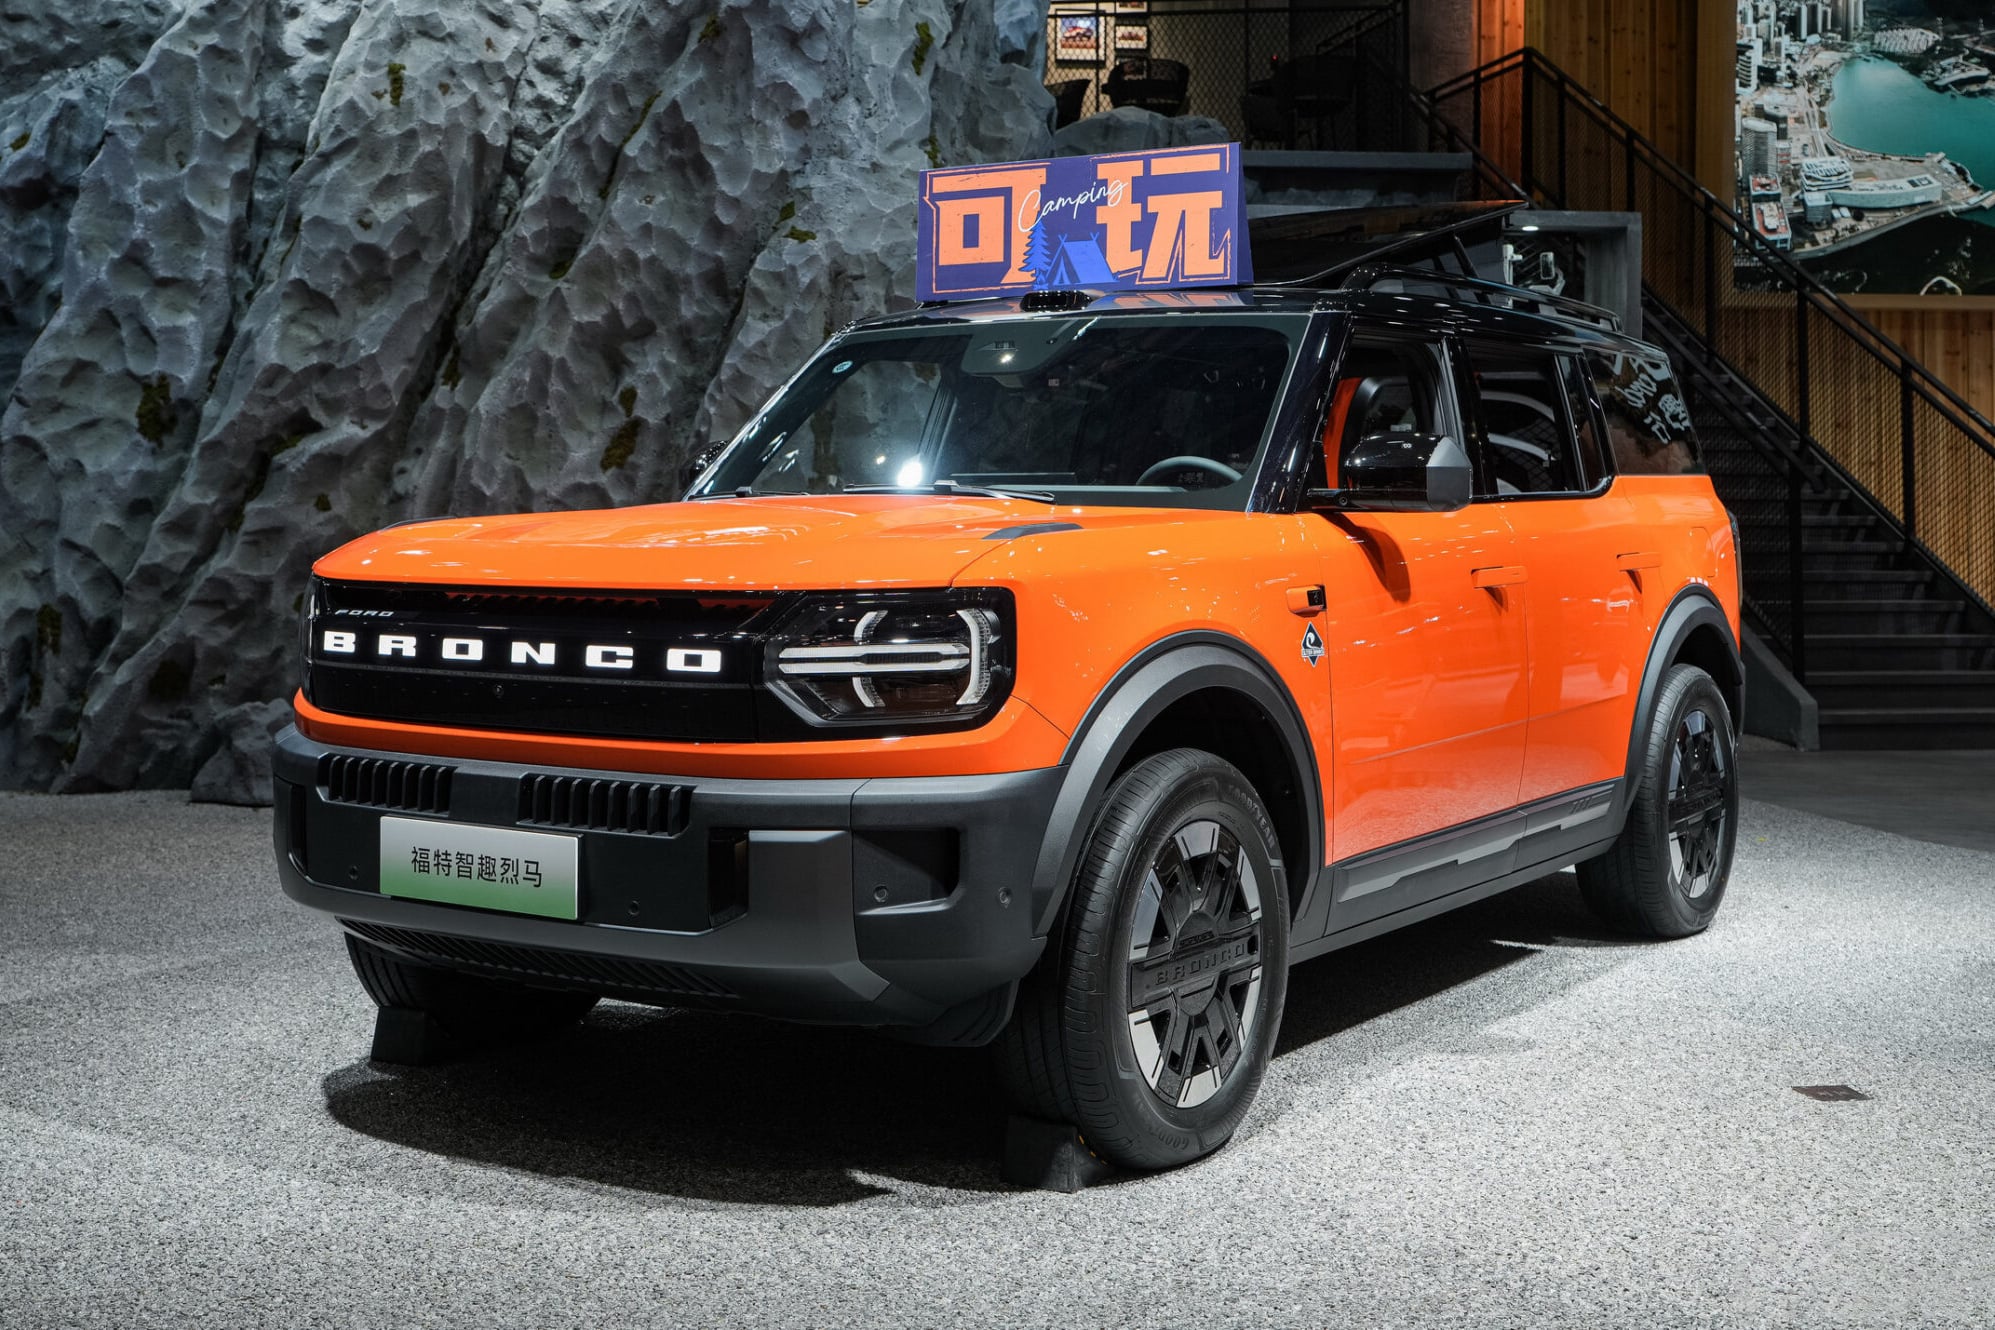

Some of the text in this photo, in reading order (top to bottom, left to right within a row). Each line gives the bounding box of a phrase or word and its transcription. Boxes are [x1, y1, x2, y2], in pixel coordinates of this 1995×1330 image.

[931, 153, 1225, 284] 可玩
[1018, 178, 1129, 233] Camping
[335, 609, 394, 617] FORD
[323, 630, 722, 672] BRONCO
[411, 846, 543, 888] 福特智趣烈马
[1155, 943, 1246, 986] BRONCO
